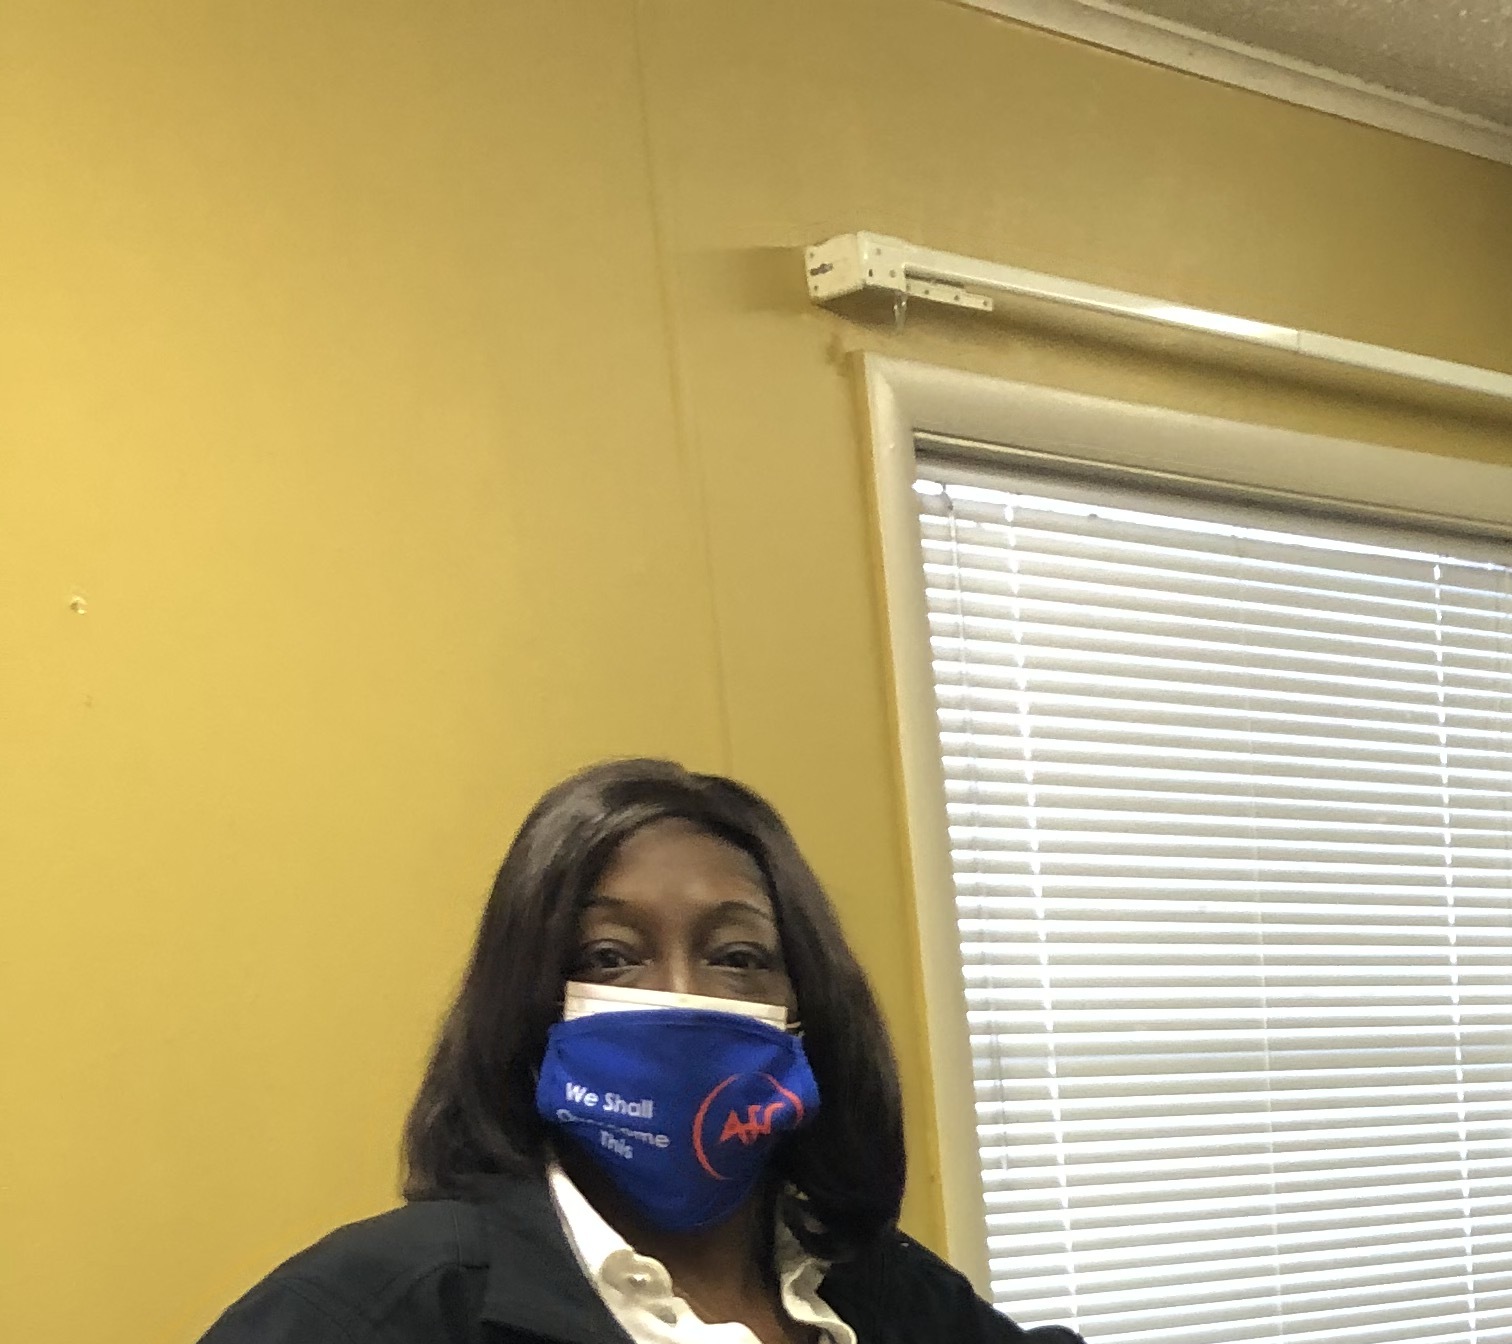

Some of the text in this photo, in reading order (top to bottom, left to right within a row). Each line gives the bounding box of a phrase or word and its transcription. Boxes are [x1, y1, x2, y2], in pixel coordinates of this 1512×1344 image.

[565, 1082, 654, 1119] We Shall
[600, 1130, 633, 1159] This
